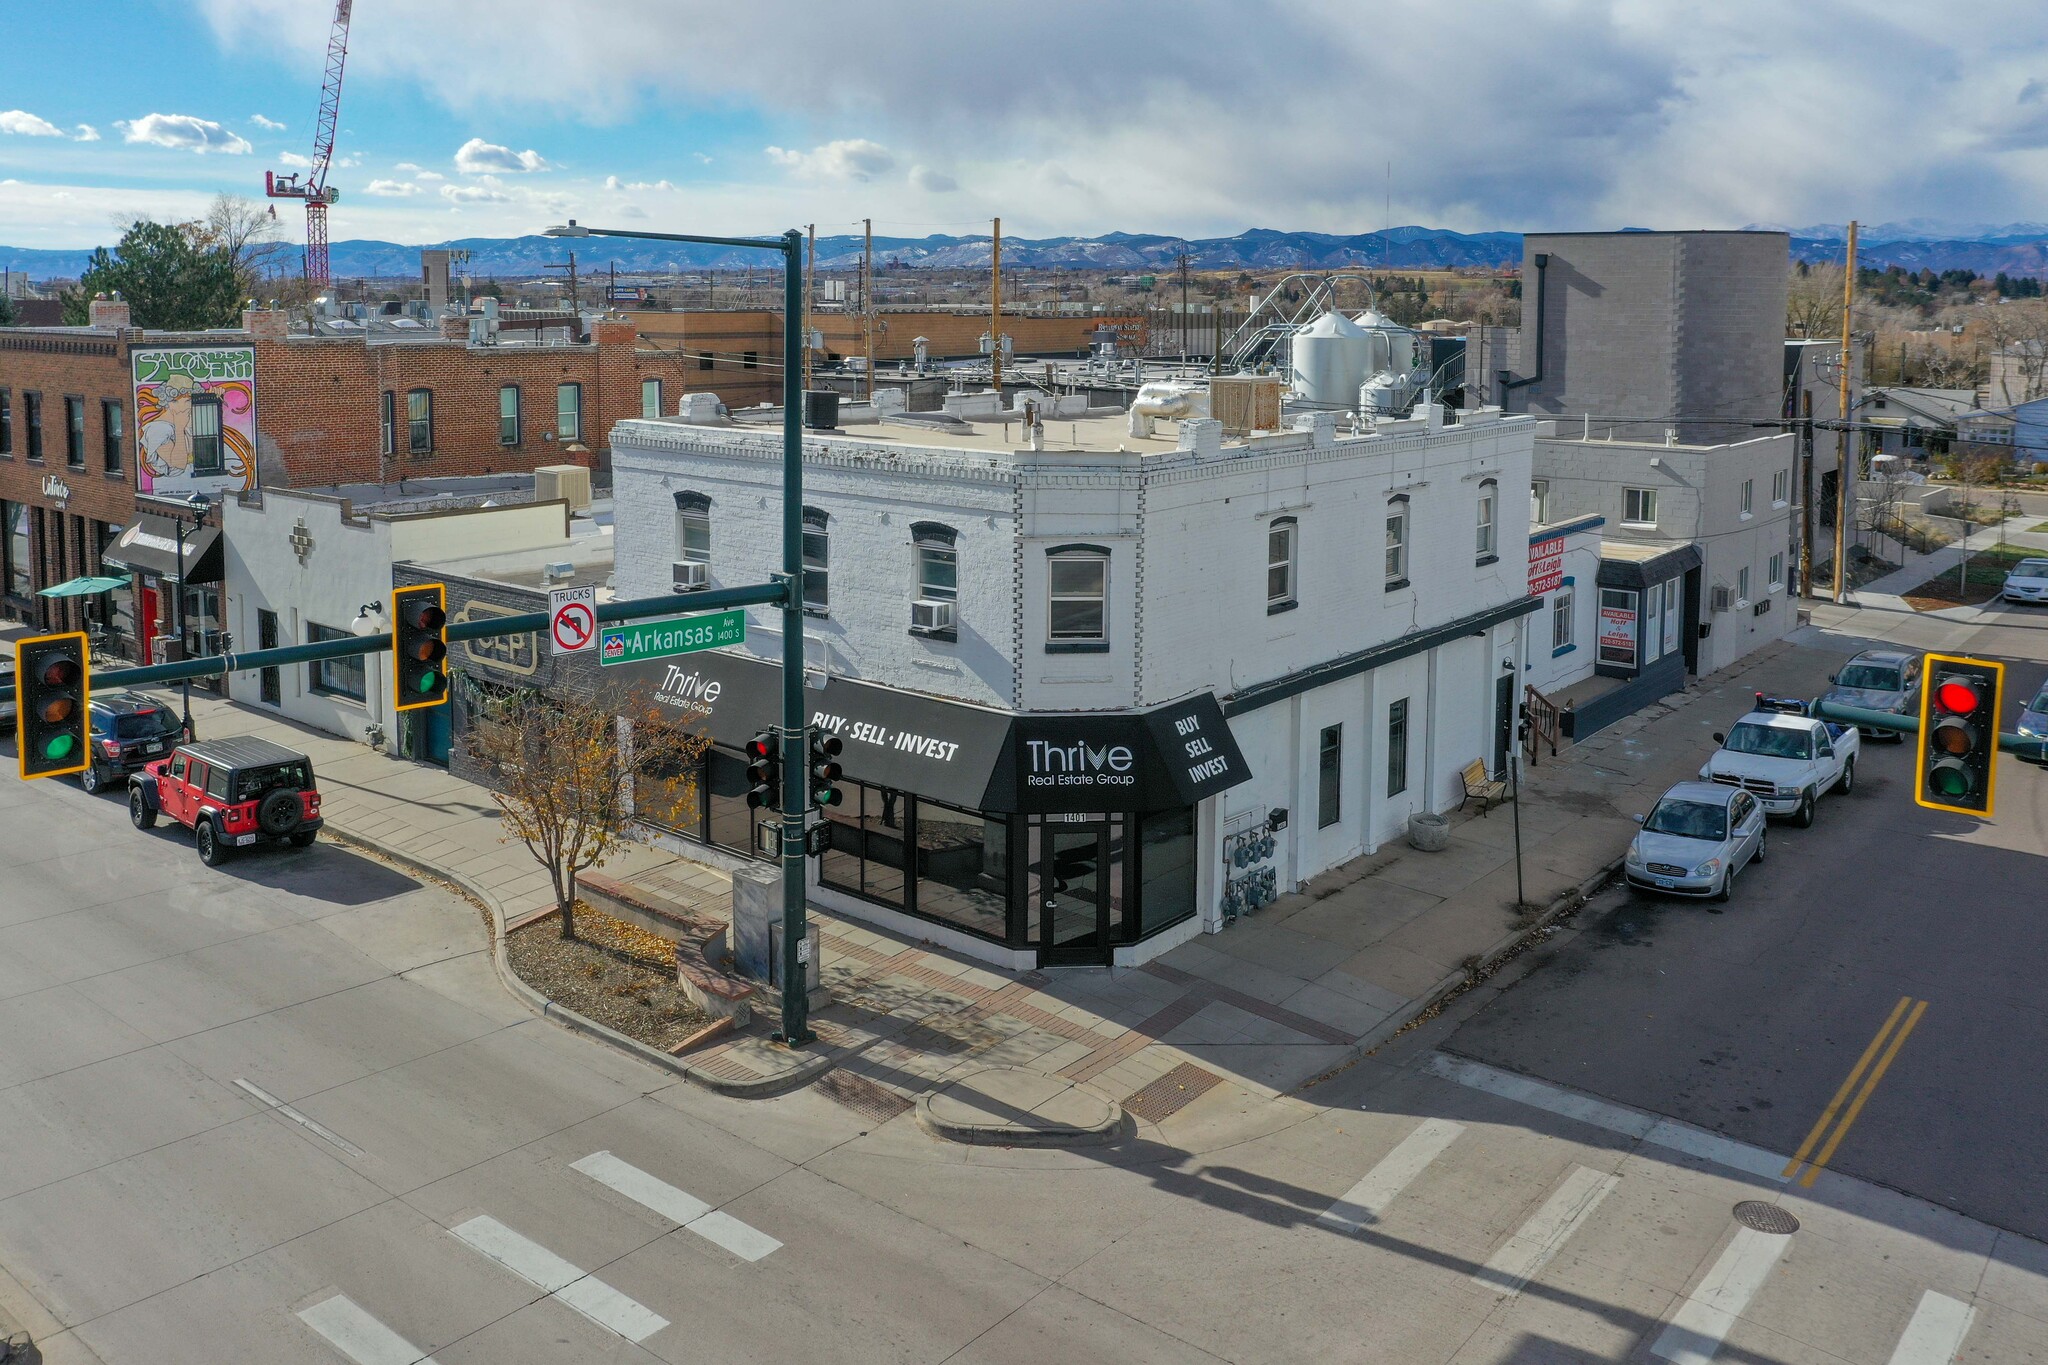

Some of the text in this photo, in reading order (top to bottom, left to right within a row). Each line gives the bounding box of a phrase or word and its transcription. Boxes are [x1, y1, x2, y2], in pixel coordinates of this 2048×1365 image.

[1529, 539, 1563, 560] VAILABLE
[554, 588, 591, 603] TRUCKS
[723, 616, 735, 628] Ave
[1602, 610, 1635, 619] AVAILABLE
[1610, 618, 1627, 626] Hoff
[625, 625, 714, 654] W Arkansas
[717, 628, 740, 641] 1400 S
[1607, 630, 1629, 639] Leigh
[604, 647, 623, 658] DENVER
[661, 664, 721, 703] Thrive
[653, 691, 713, 716] Real Estate Group
[1174, 714, 1201, 736] BUY
[810, 711, 959, 762] BUY SELL INVEST
[1026, 740, 1133, 772] Thrive
[1185, 737, 1213, 759] SELL
[1188, 755, 1229, 784] INVEST
[1028, 773, 1135, 786] Real Estate Group
[1065, 813, 1086, 822] 1401
